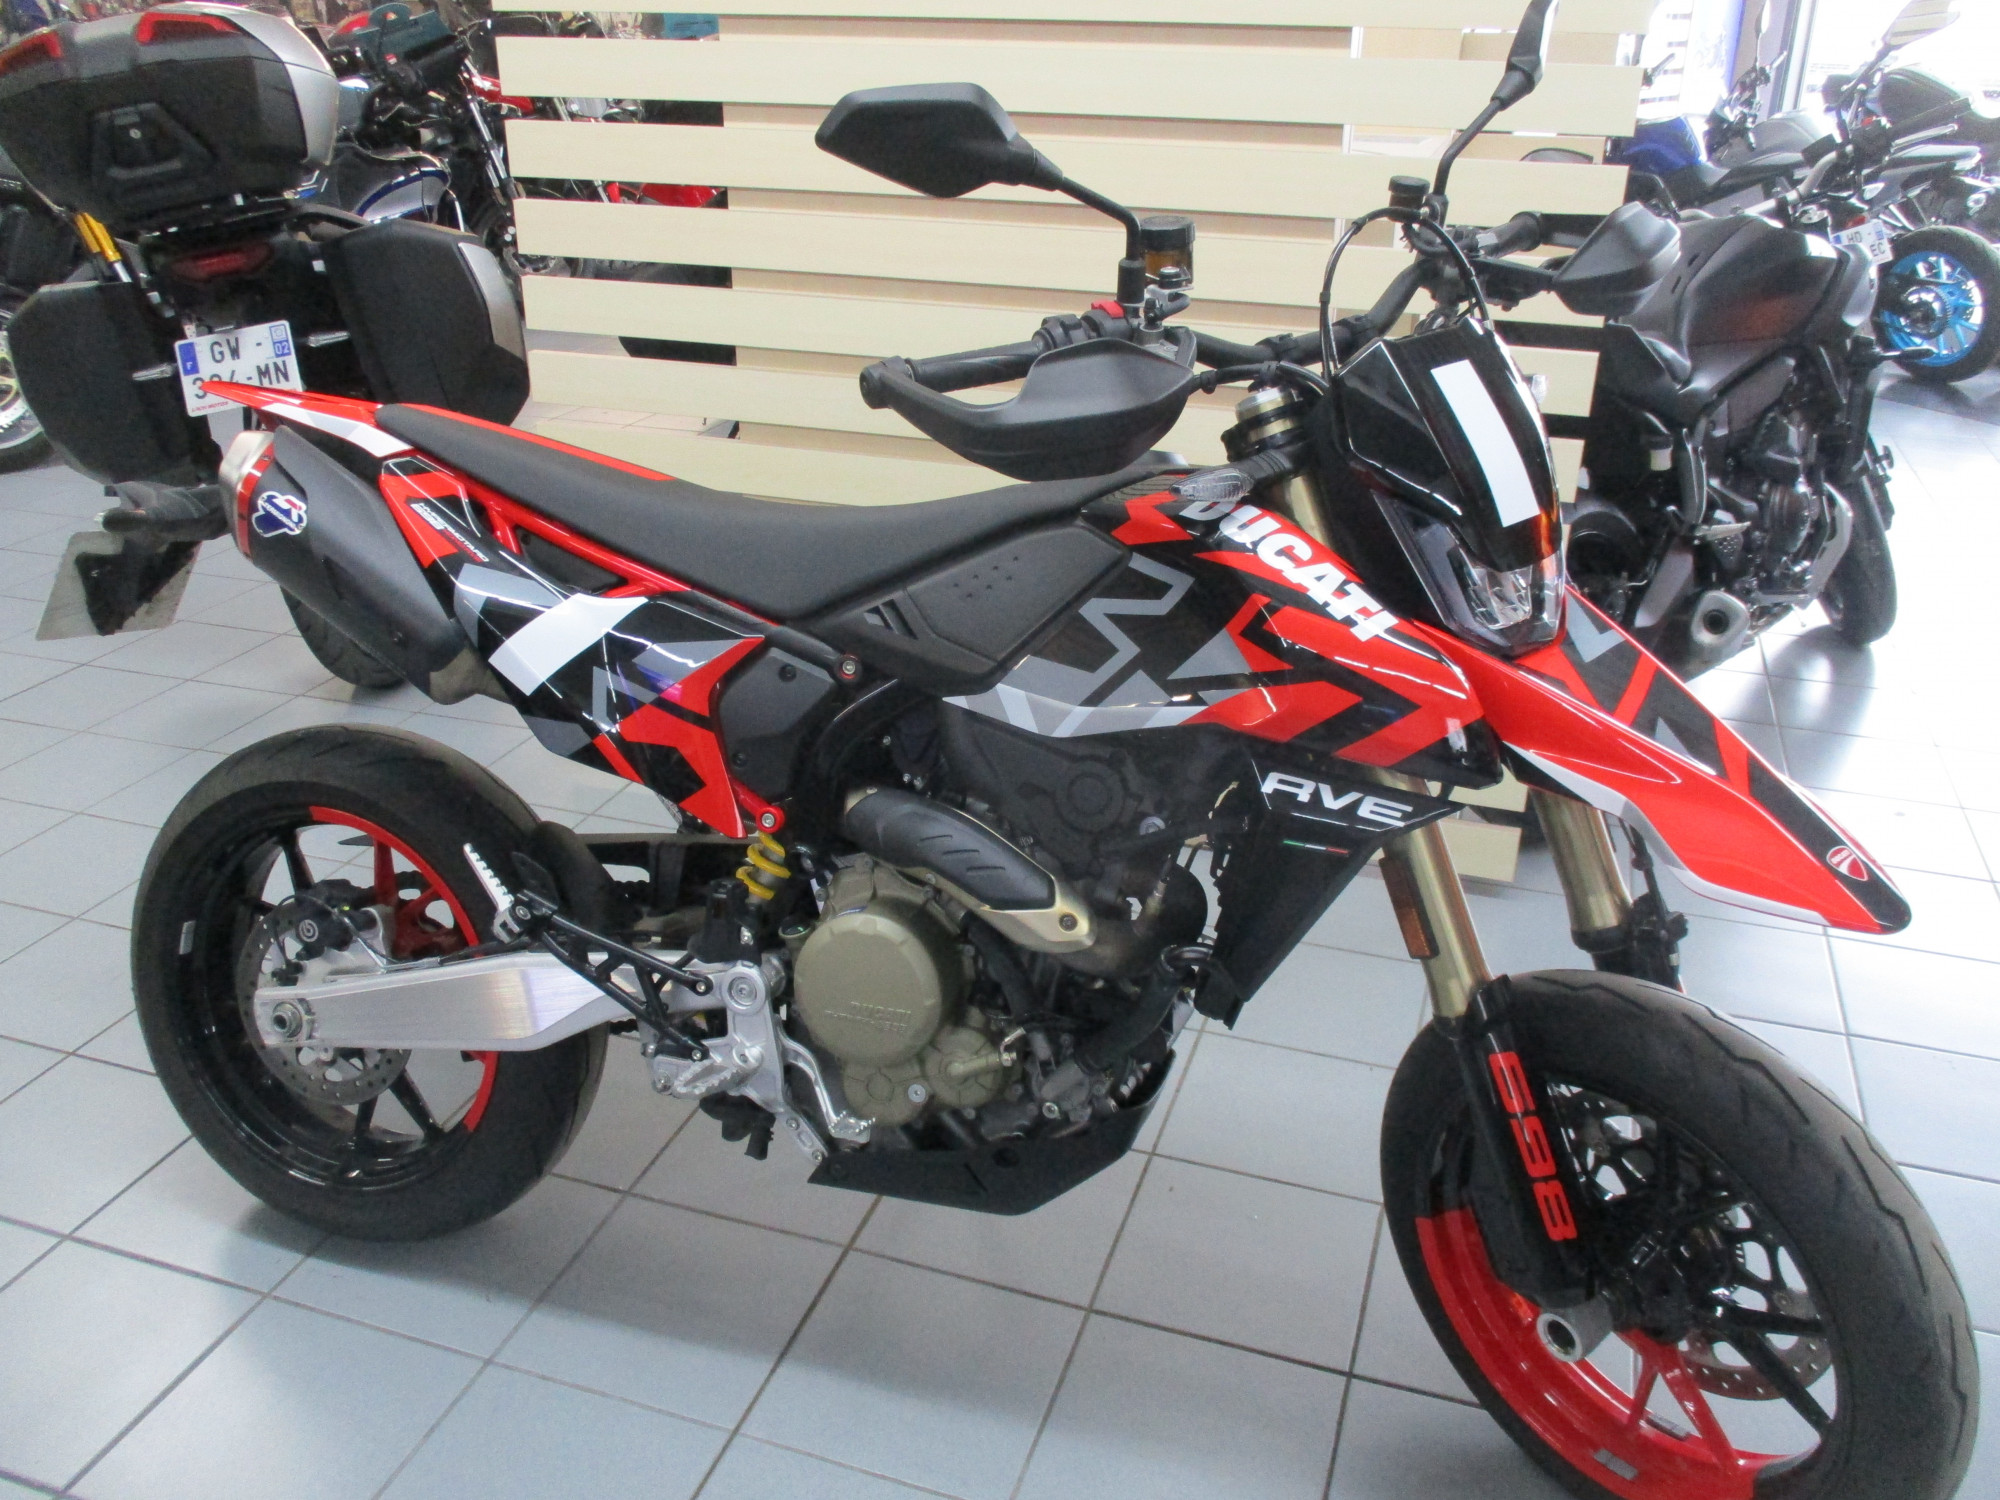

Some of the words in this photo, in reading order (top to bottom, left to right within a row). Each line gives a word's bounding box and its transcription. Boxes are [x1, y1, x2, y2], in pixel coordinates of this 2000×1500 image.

[185, 361, 193, 371] F
[210, 337, 241, 364] GW
[274, 342, 291, 355] 02
[1179, 501, 1399, 643] DUCATI
[1260, 771, 1414, 828] RVE
[1488, 1051, 1578, 1241] 698
